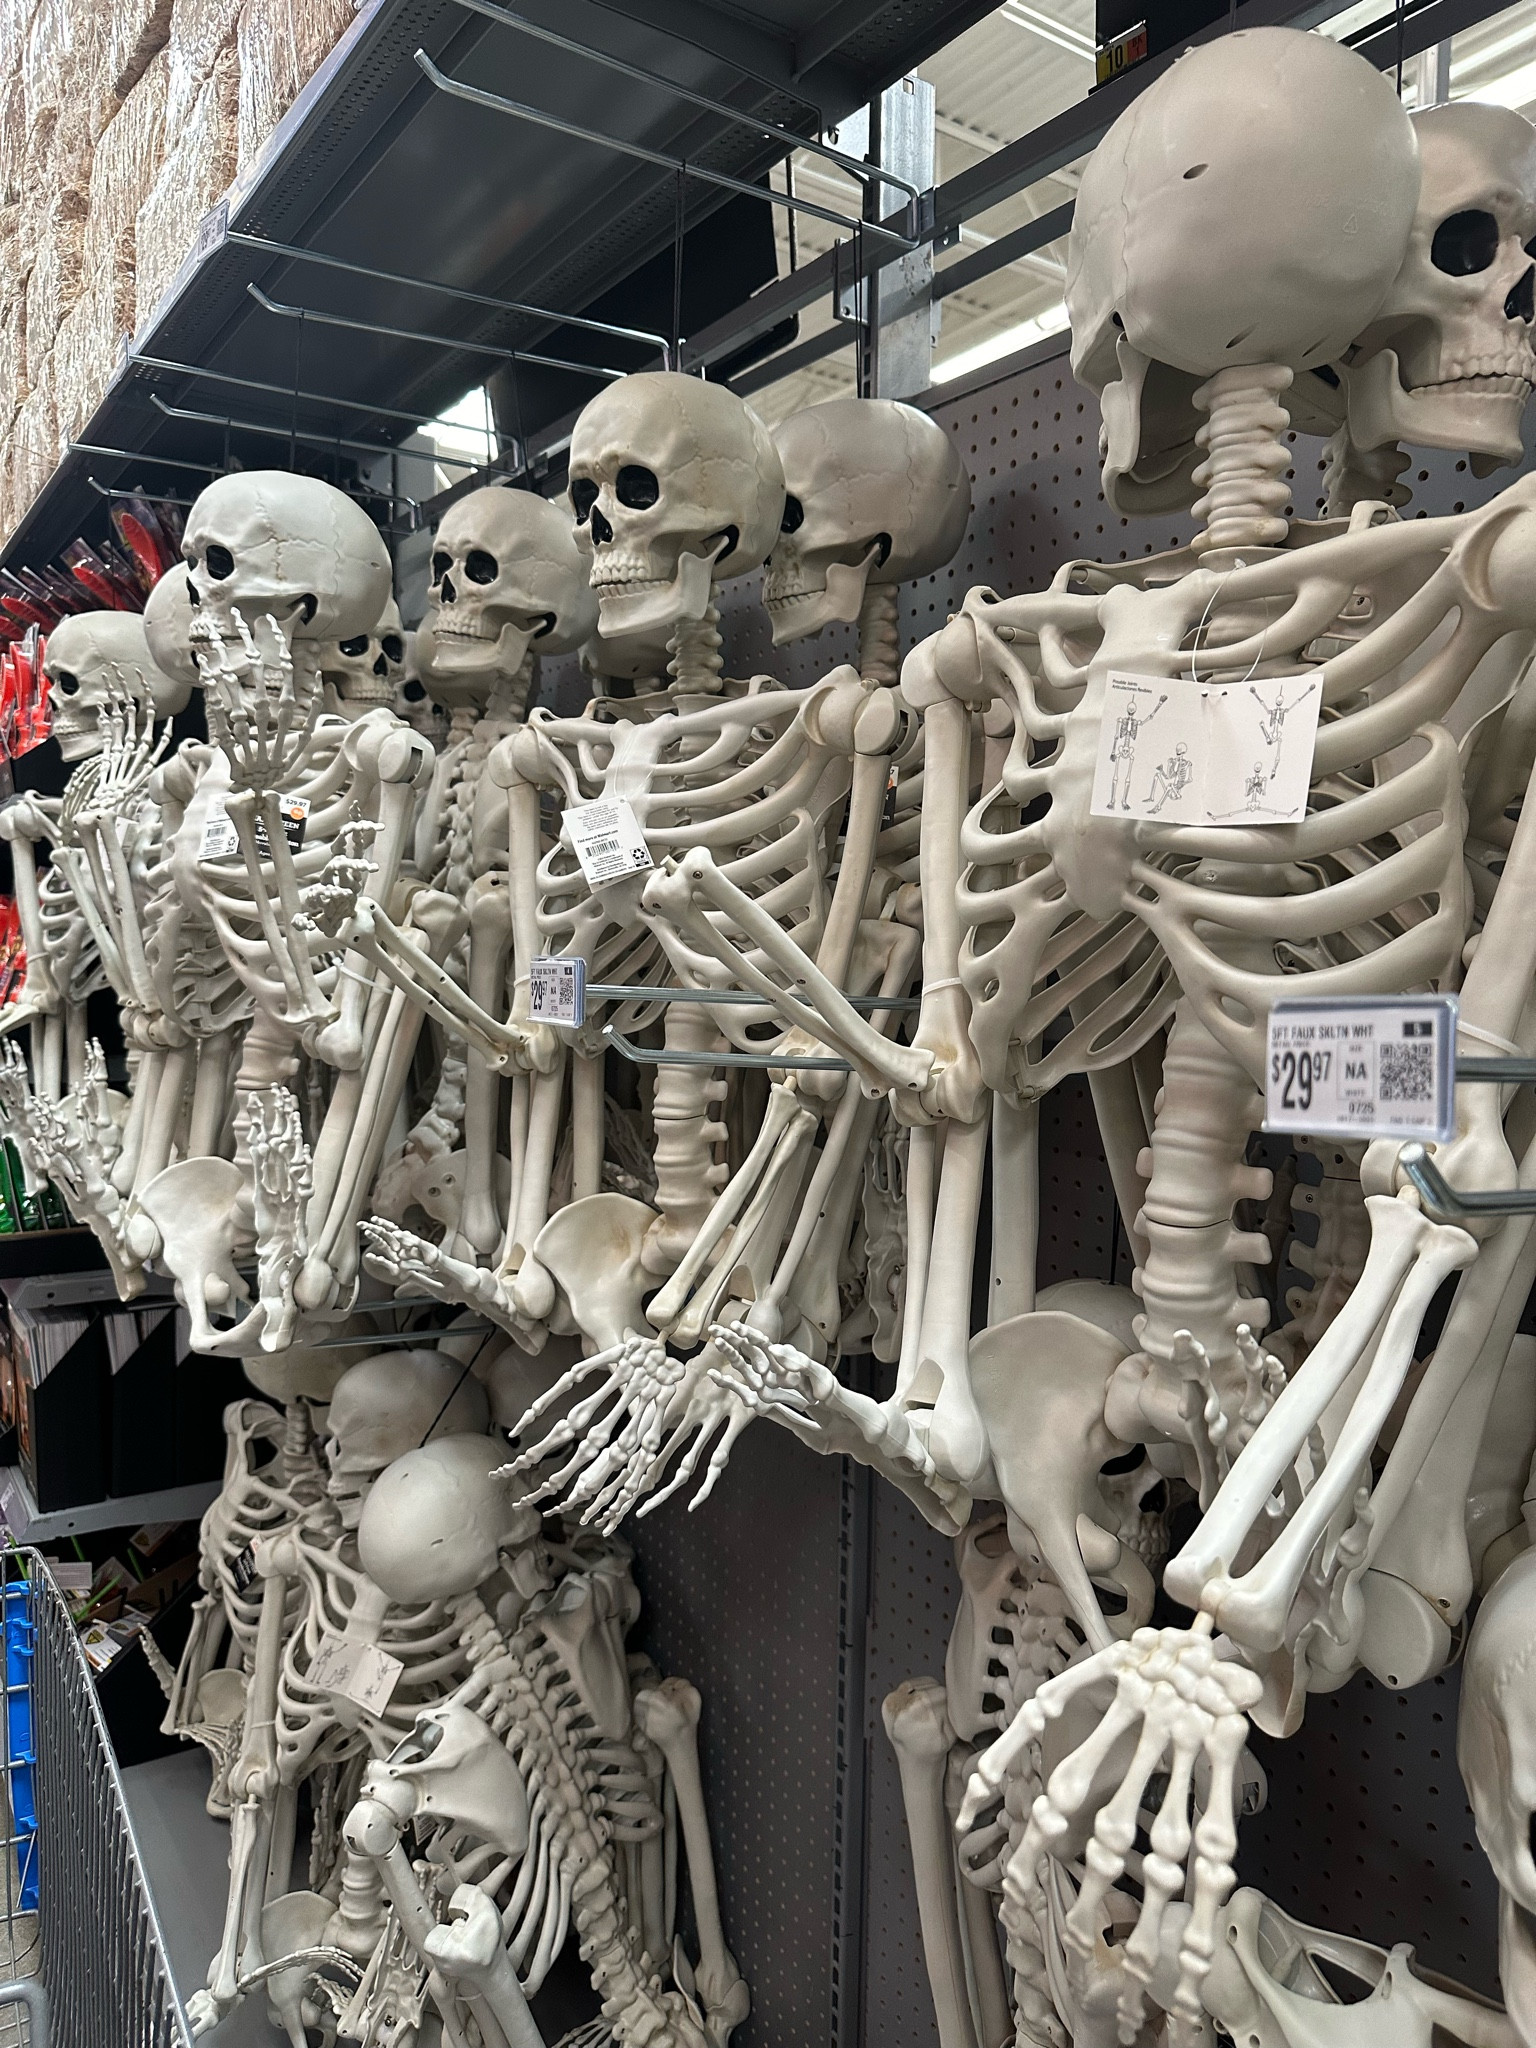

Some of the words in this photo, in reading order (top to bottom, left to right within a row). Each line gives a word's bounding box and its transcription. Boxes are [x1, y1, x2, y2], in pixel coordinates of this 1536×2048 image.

[1106, 45, 1123, 73] 10
[286, 799, 307, 807] $29.97
[1291, 1026, 1315, 1039] FAUX
[1319, 1025, 1348, 1039] SKLTN
[1351, 1024, 1374, 1038] WHT
[1345, 1062, 1367, 1080] NA
